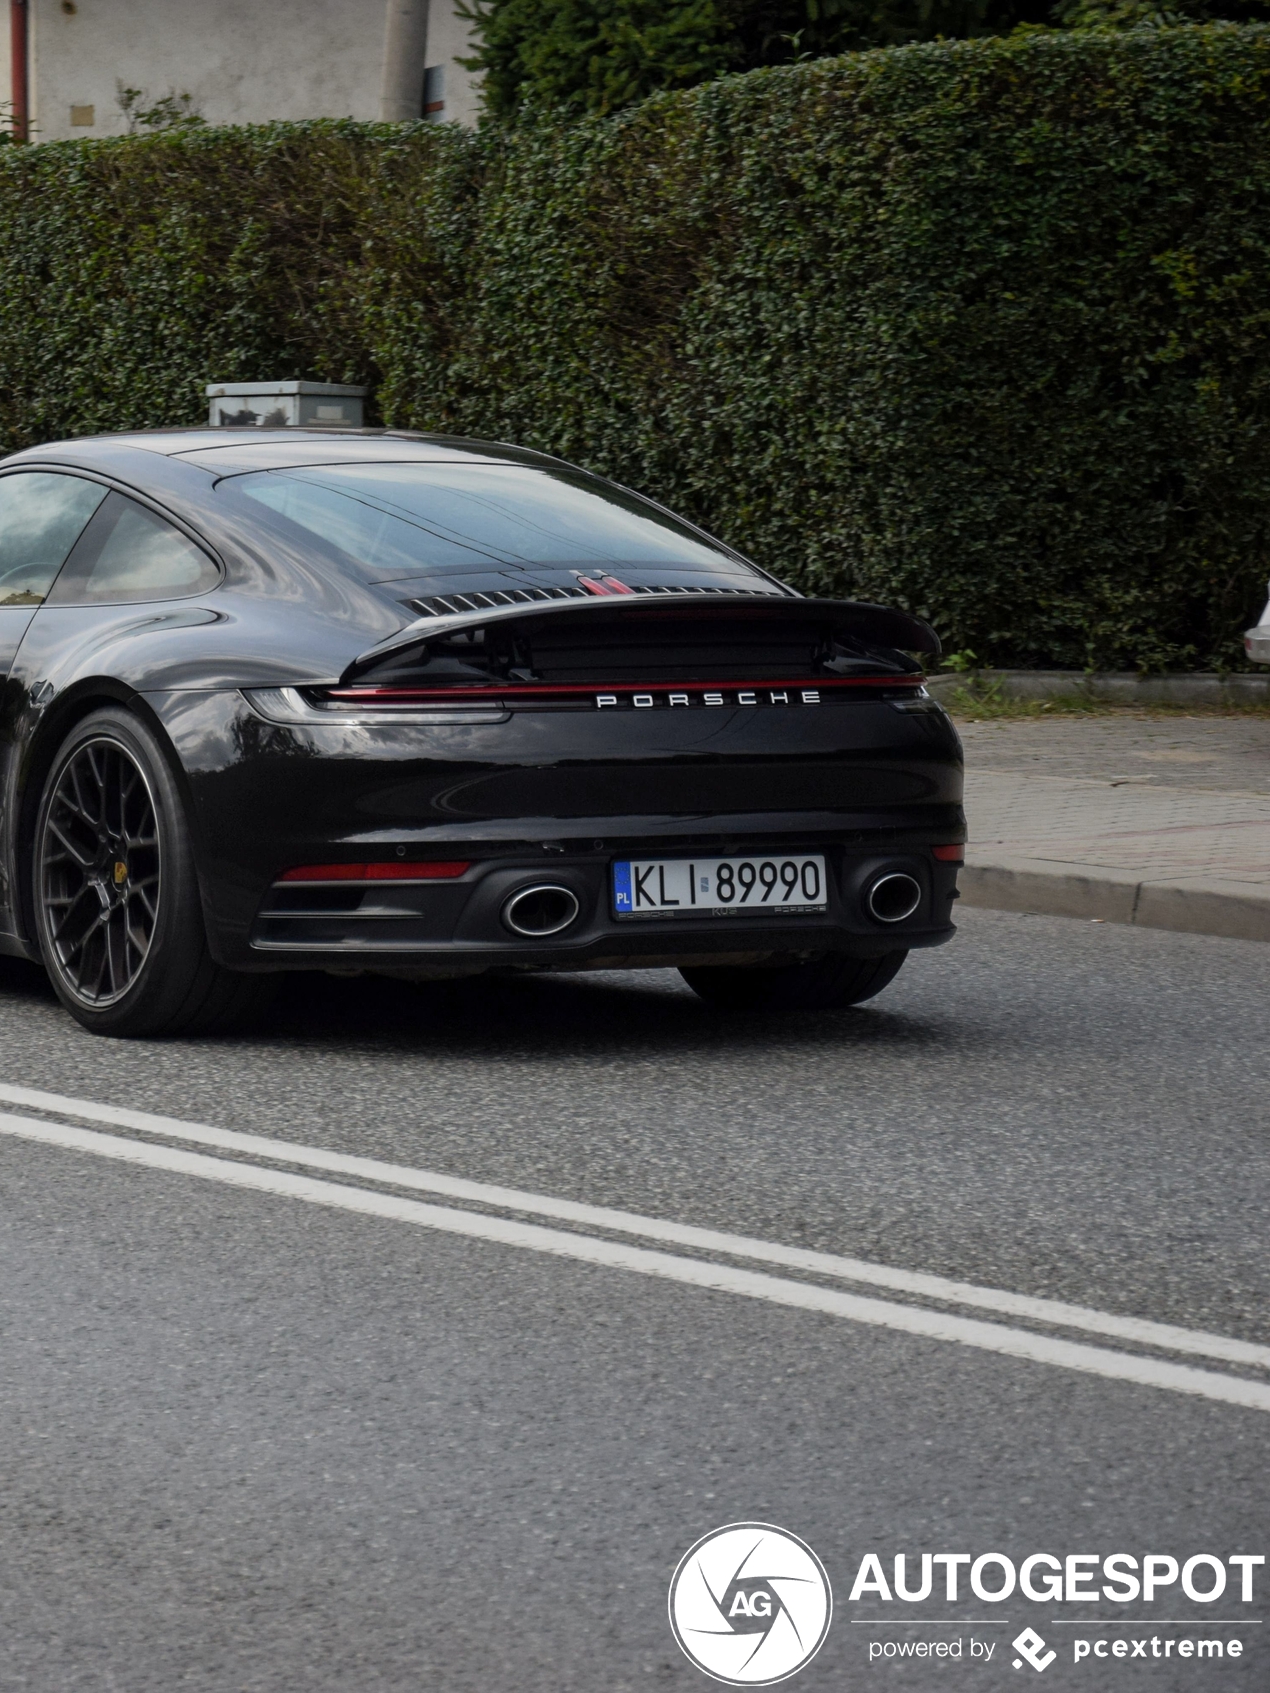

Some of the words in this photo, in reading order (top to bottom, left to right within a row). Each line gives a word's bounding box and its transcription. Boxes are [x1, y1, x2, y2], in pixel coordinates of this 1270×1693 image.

[596, 691, 821, 708] PORSCHE
[634, 865, 696, 906] KLI
[716, 860, 820, 903] 89990
[616, 893, 630, 904] PL
[618, 911, 674, 919] PORSCHE
[773, 905, 826, 913] PORSCHE
